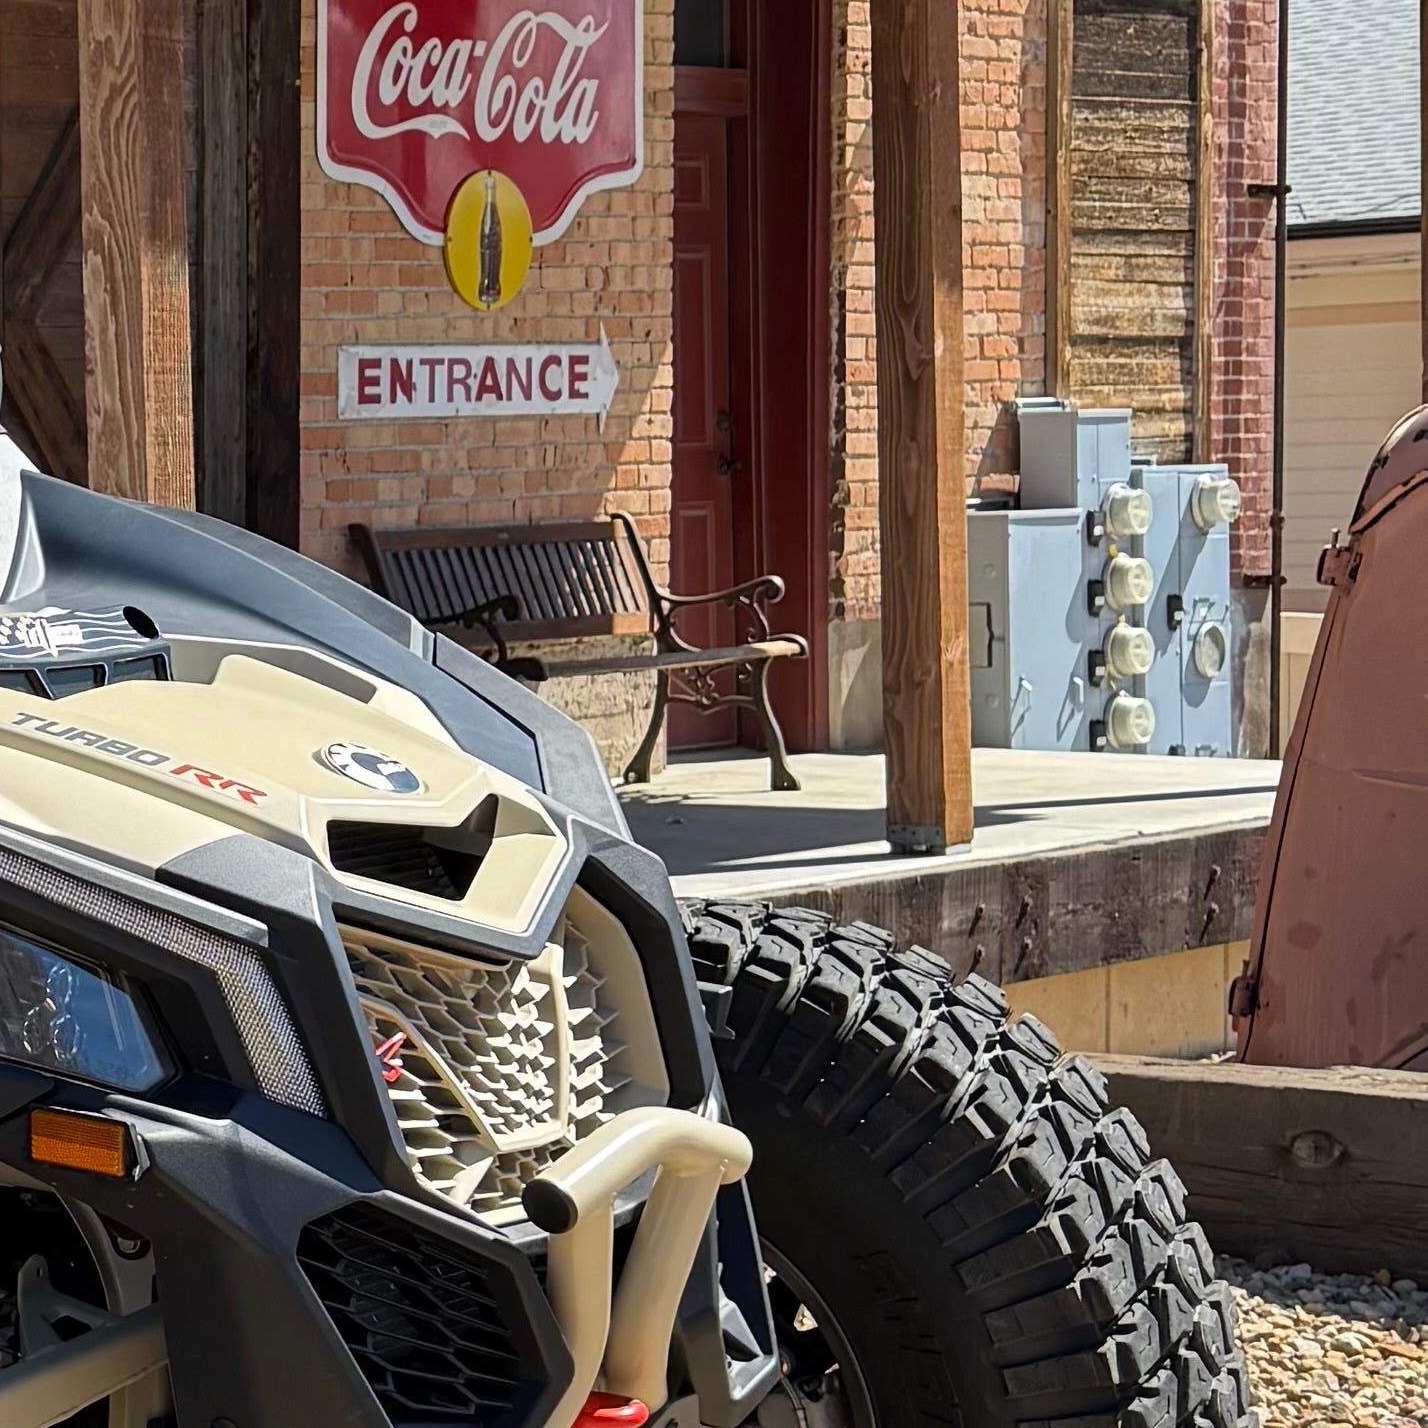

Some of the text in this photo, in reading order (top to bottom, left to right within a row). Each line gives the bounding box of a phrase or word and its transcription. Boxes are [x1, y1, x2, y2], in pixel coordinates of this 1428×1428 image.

[351, 1, 609, 145] Coca-Cola
[356, 354, 591, 406] ENTRANCE
[11, 711, 269, 806] TURBO RR
